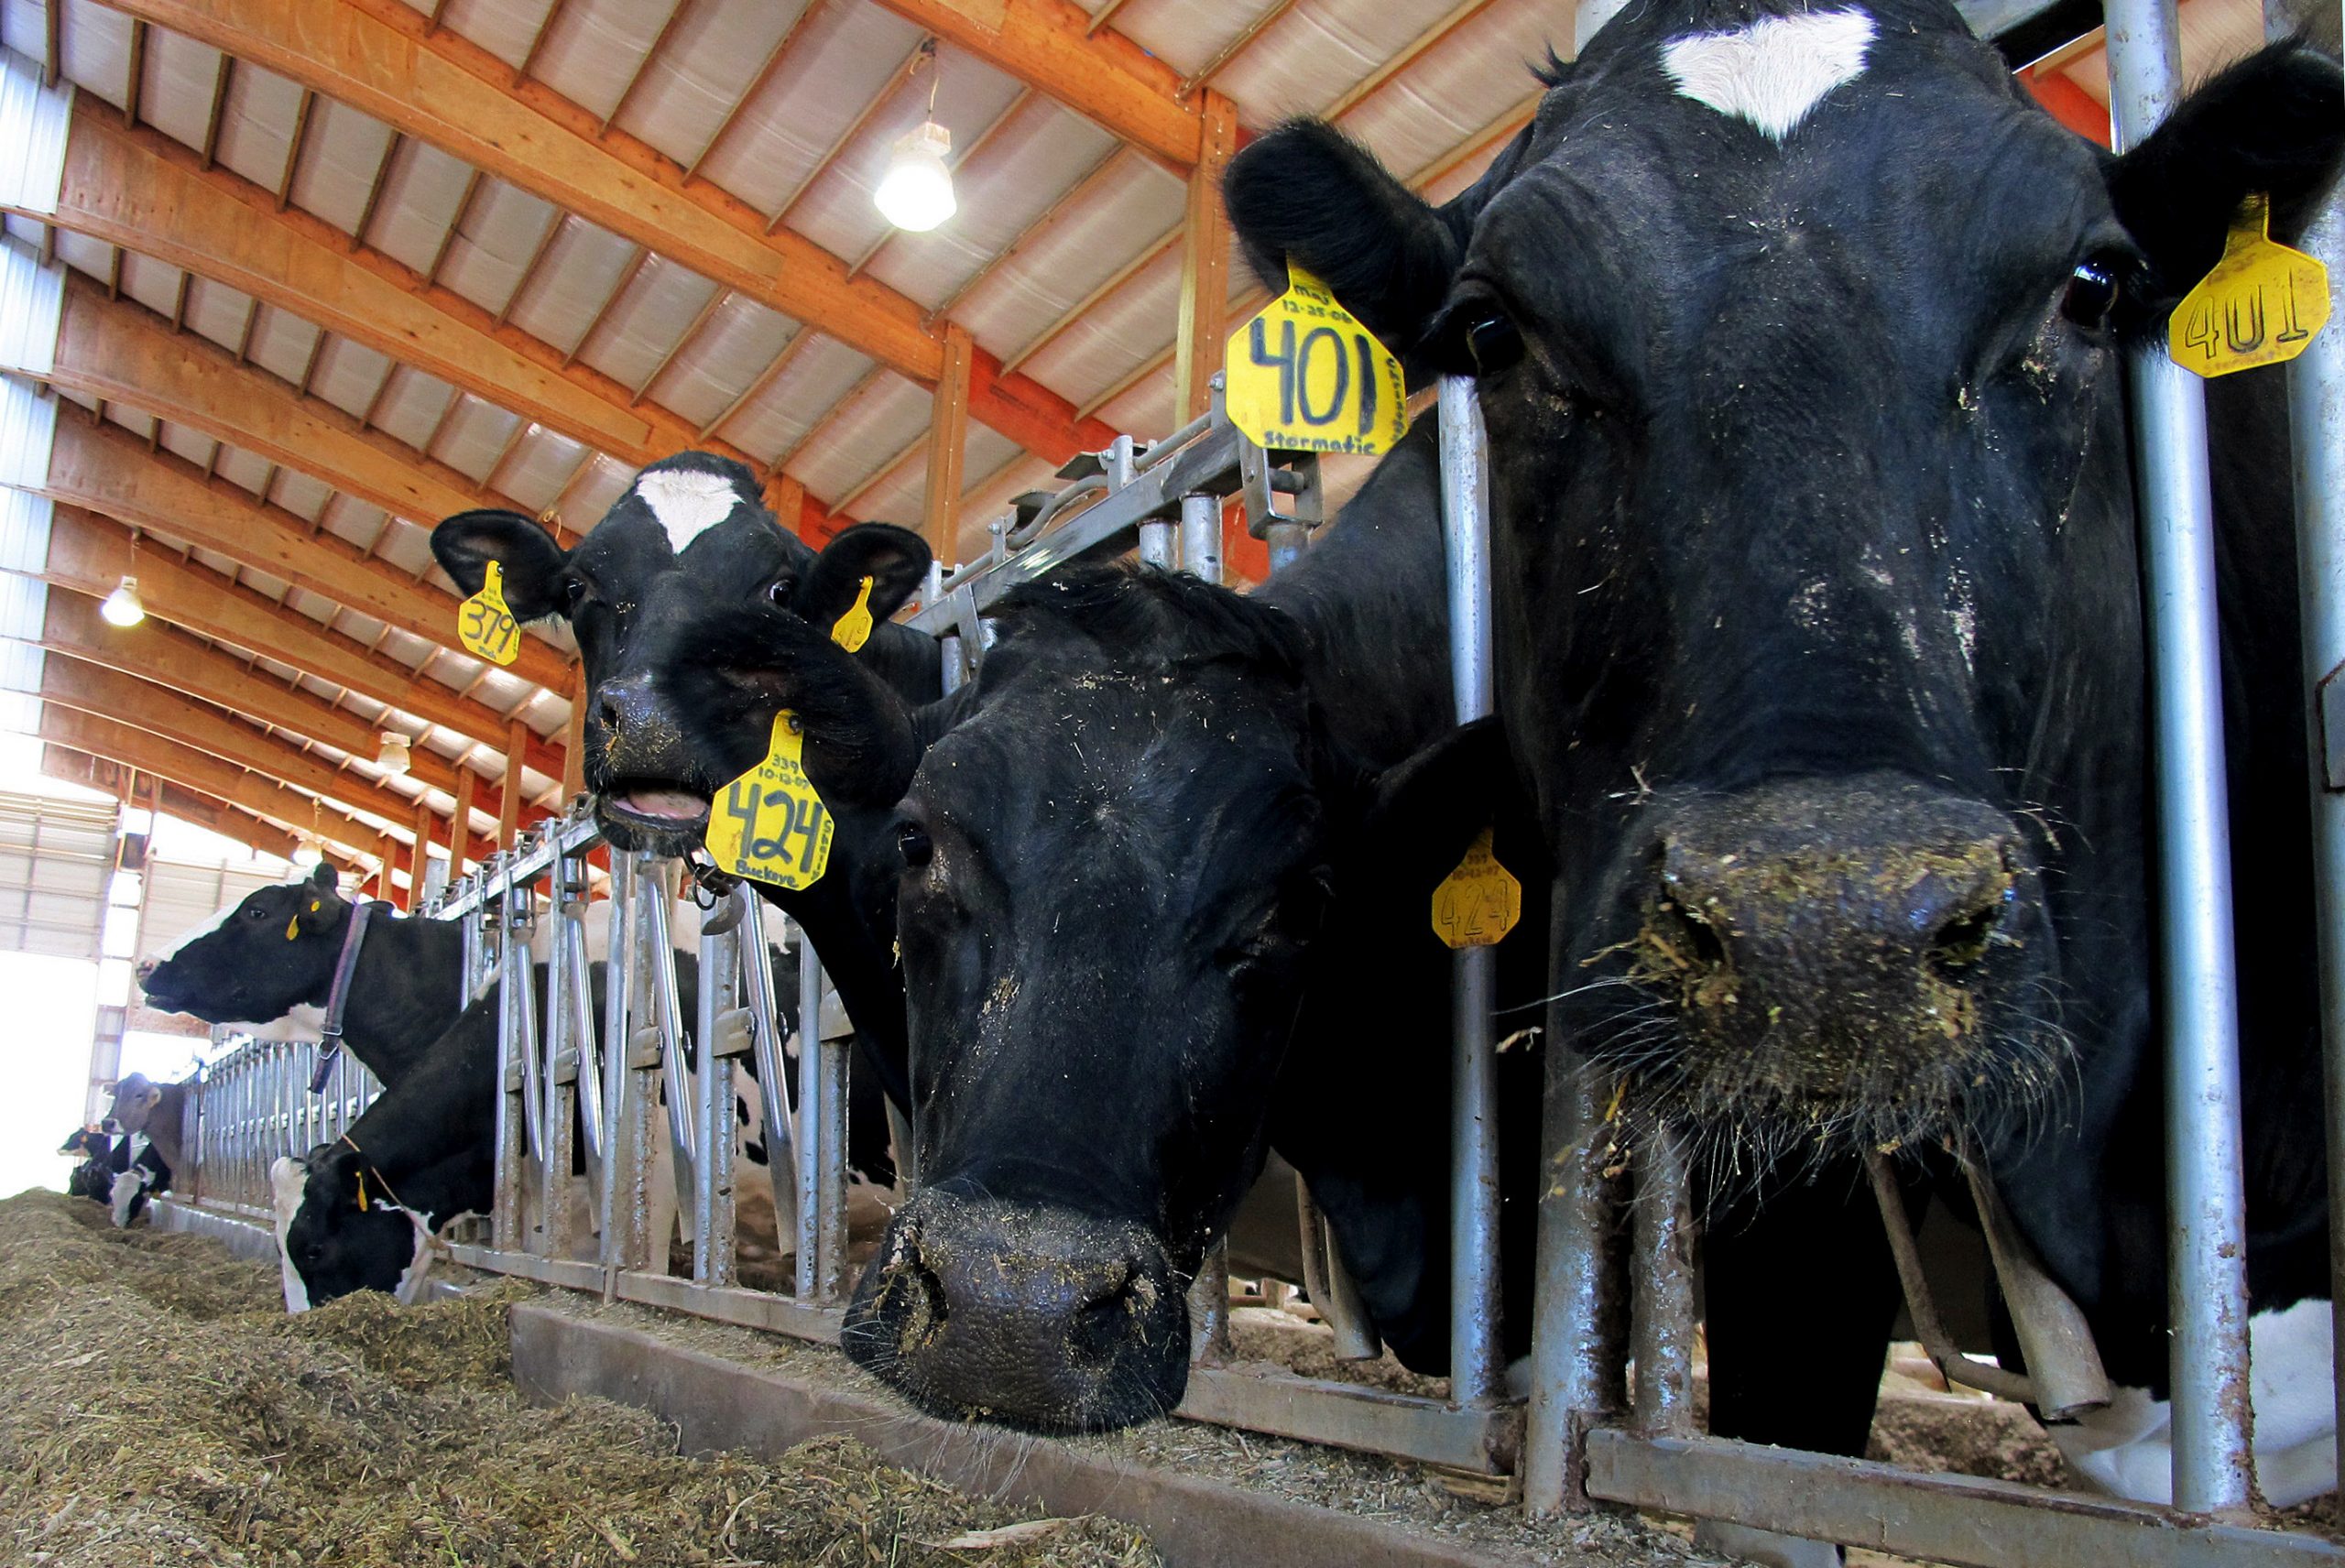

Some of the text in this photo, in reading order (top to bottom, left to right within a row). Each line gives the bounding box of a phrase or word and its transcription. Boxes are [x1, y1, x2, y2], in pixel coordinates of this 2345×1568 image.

[2185, 267, 2308, 359] 401
[1249, 316, 1378, 437] 401
[1264, 430, 1376, 454] Stormatic
[464, 598, 515, 653] 379
[772, 753, 800, 774] 339
[727, 780, 824, 874] 424
[736, 859, 799, 889] Buckeye
[1441, 879, 1510, 936] 424
